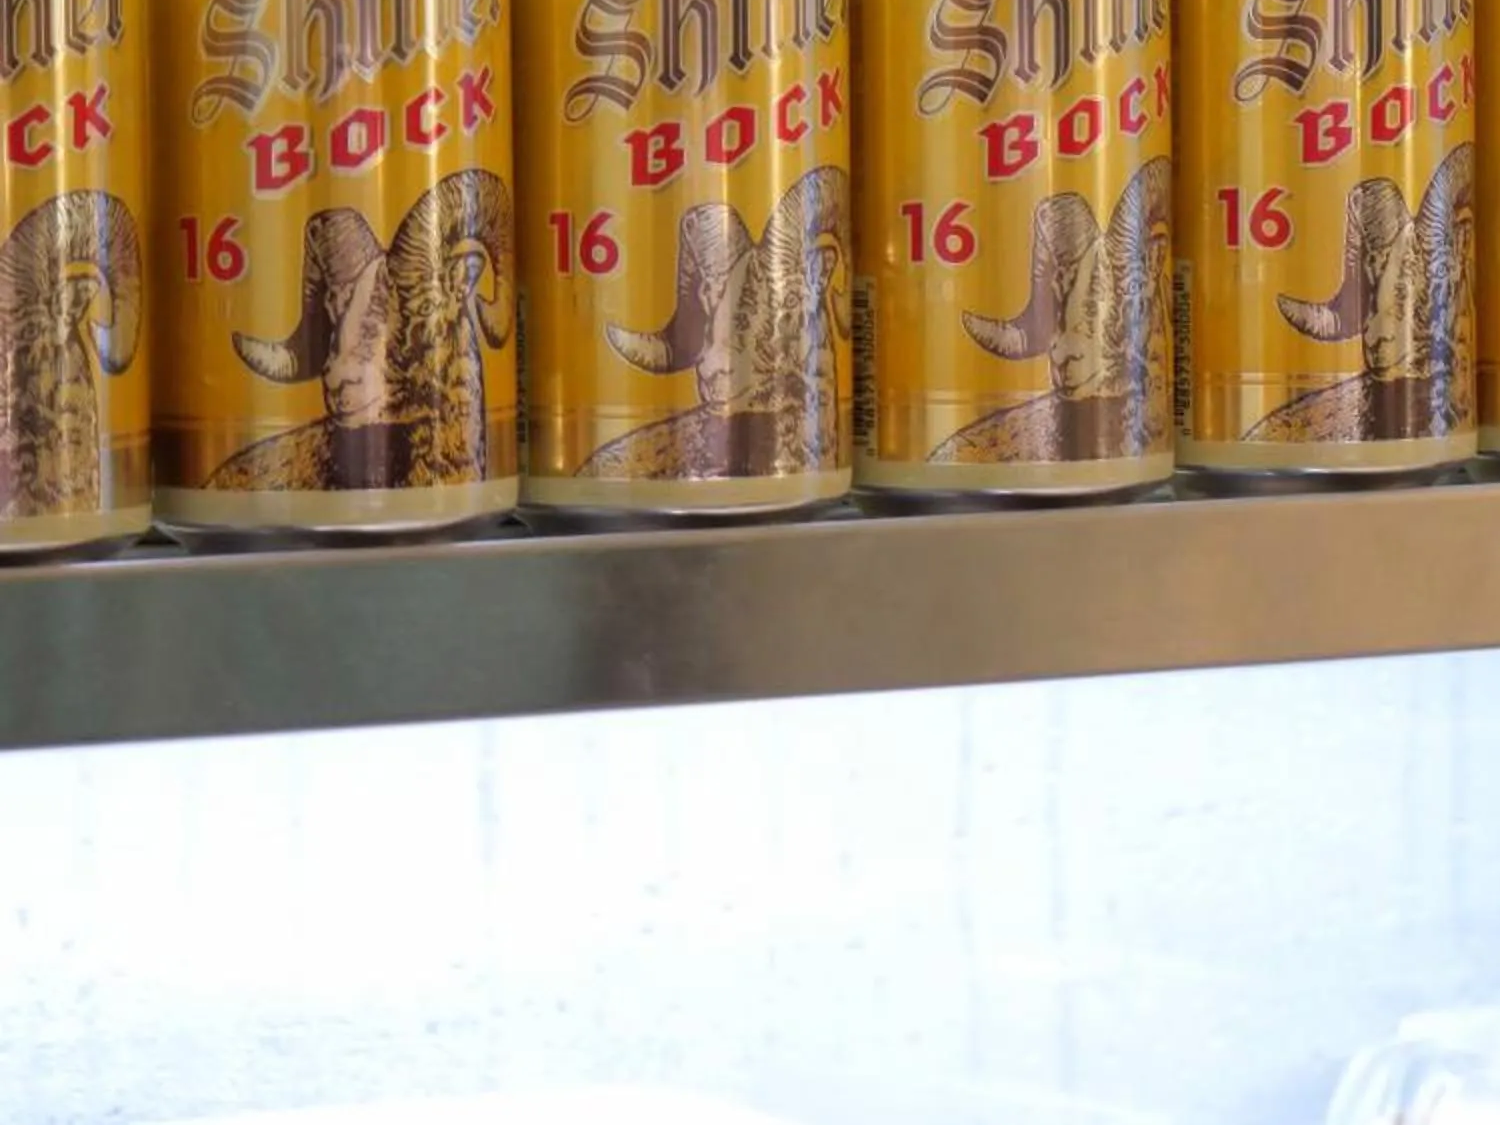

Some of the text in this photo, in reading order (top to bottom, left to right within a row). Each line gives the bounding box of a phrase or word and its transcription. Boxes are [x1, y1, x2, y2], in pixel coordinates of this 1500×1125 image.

[7, 84, 112, 167] CK
[246, 65, 497, 191] BOCK
[624, 65, 843, 187] BOCK
[180, 216, 245, 283] 16
[549, 211, 619, 275] 16
[901, 201, 976, 264] 16
[1218, 187, 1291, 248] 16
